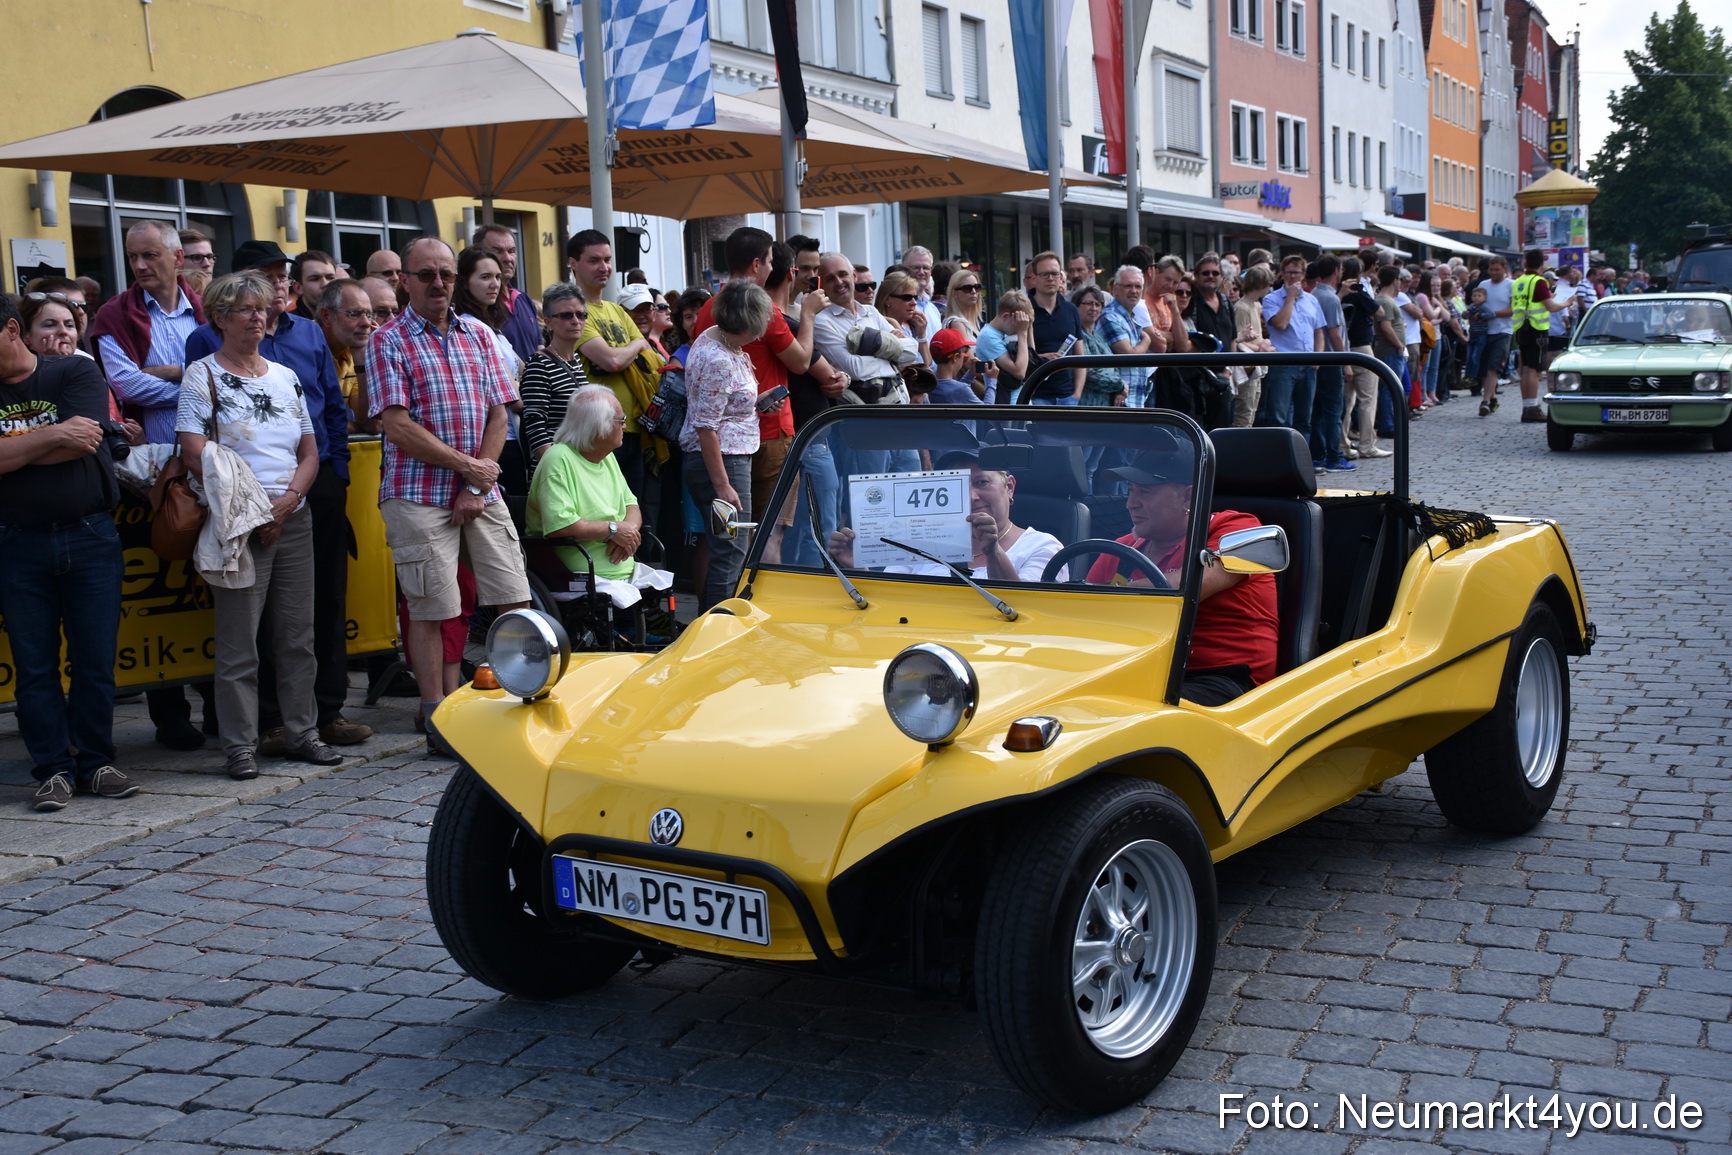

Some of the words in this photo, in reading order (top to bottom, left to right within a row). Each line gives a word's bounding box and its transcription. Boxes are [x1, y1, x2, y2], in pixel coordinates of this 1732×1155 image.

[218, 100, 400, 123] Neumarkter
[151, 110, 405, 139] Lammsbräu
[542, 232, 554, 247] 24
[1608, 410, 1622, 420] RH
[1628, 410, 1641, 420] BM
[1643, 410, 1669, 420] 878H
[907, 486, 949, 508] 476
[562, 887, 570, 898] D
[574, 866, 619, 910] NM
[639, 877, 686, 922] PG
[693, 886, 763, 937] 57H
